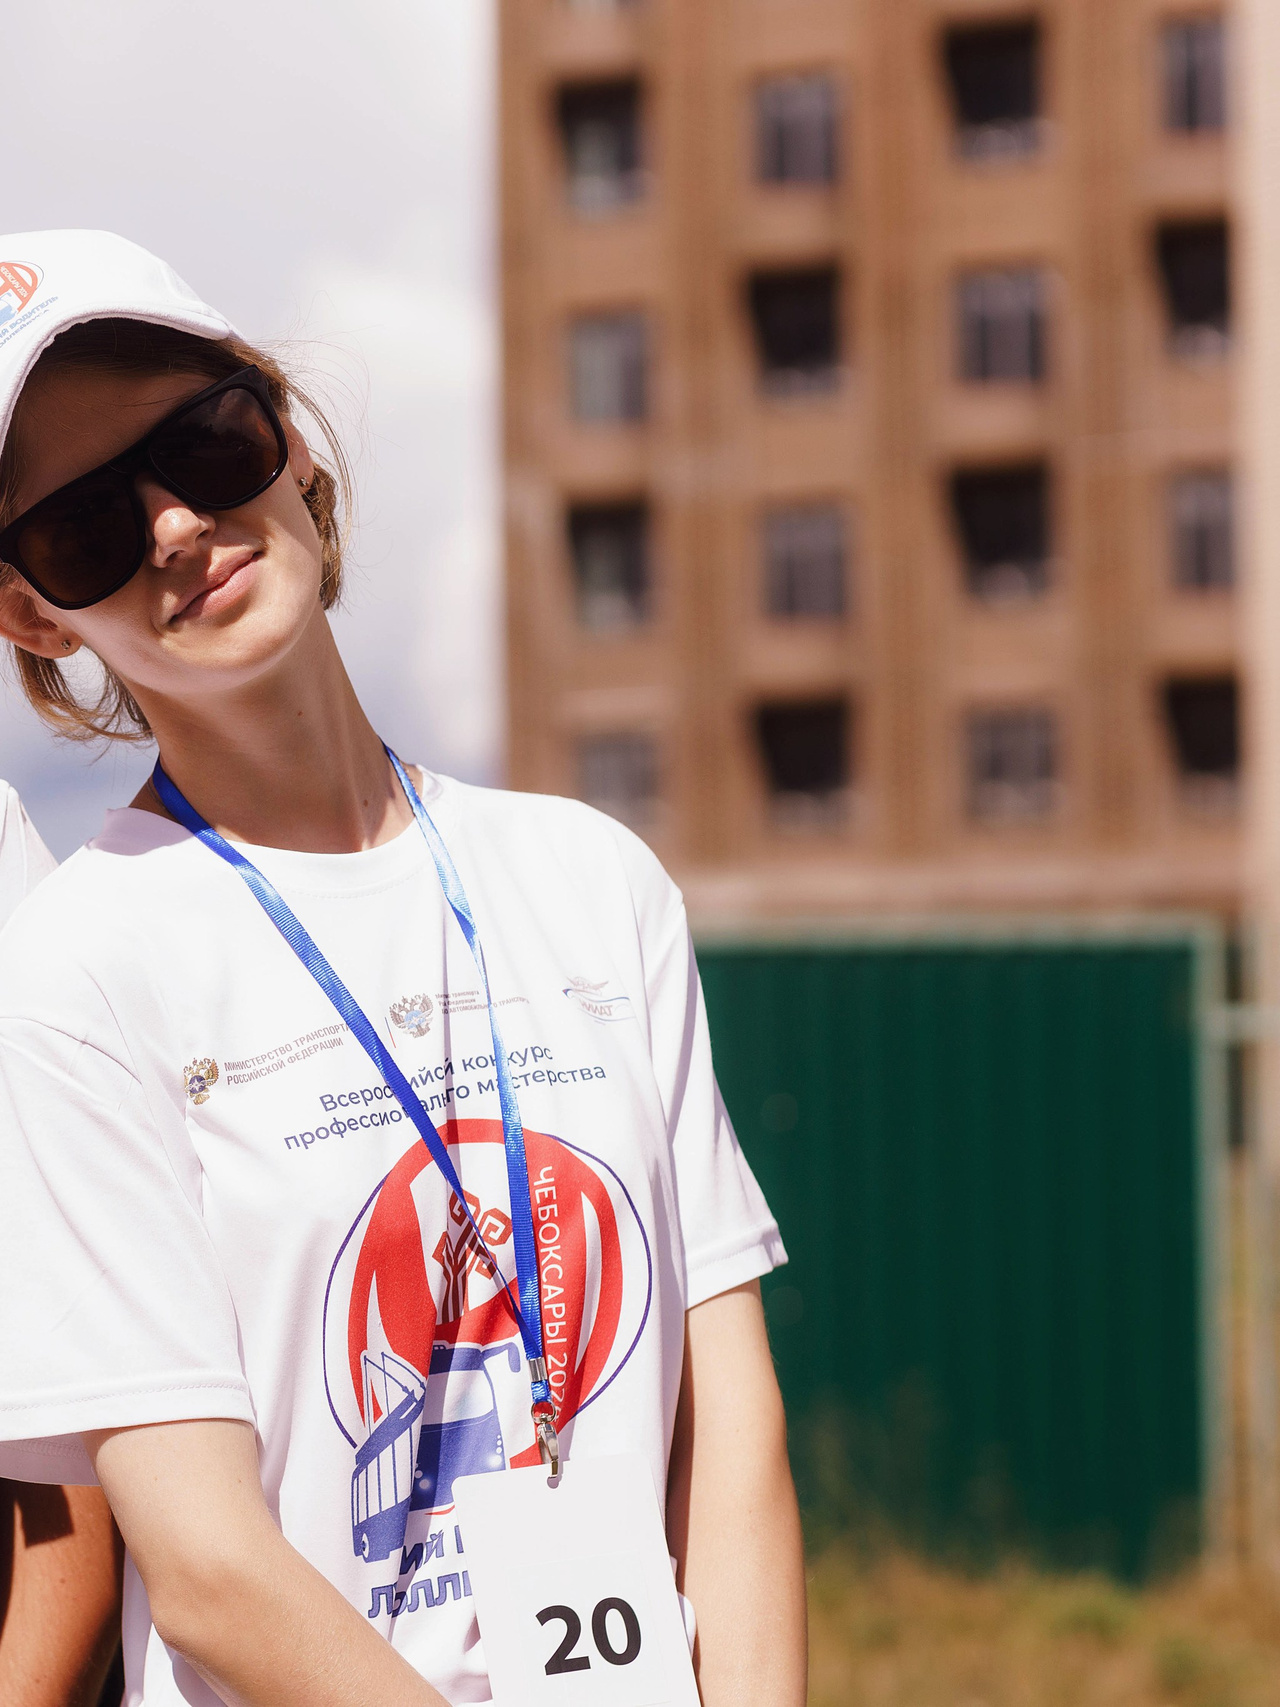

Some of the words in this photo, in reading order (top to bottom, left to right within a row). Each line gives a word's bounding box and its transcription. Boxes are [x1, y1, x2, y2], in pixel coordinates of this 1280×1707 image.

[224, 1043, 293, 1072] МИНИСТЕРСТВО
[227, 1059, 286, 1085] РОССИЙСКОЙ
[287, 1038, 344, 1064] ФЕДЕРАЦИИ
[477, 1066, 606, 1094] мстерства
[533, 1166, 567, 1344] ЧЕБОКСАРЫ
[535, 1596, 642, 1676] 20
